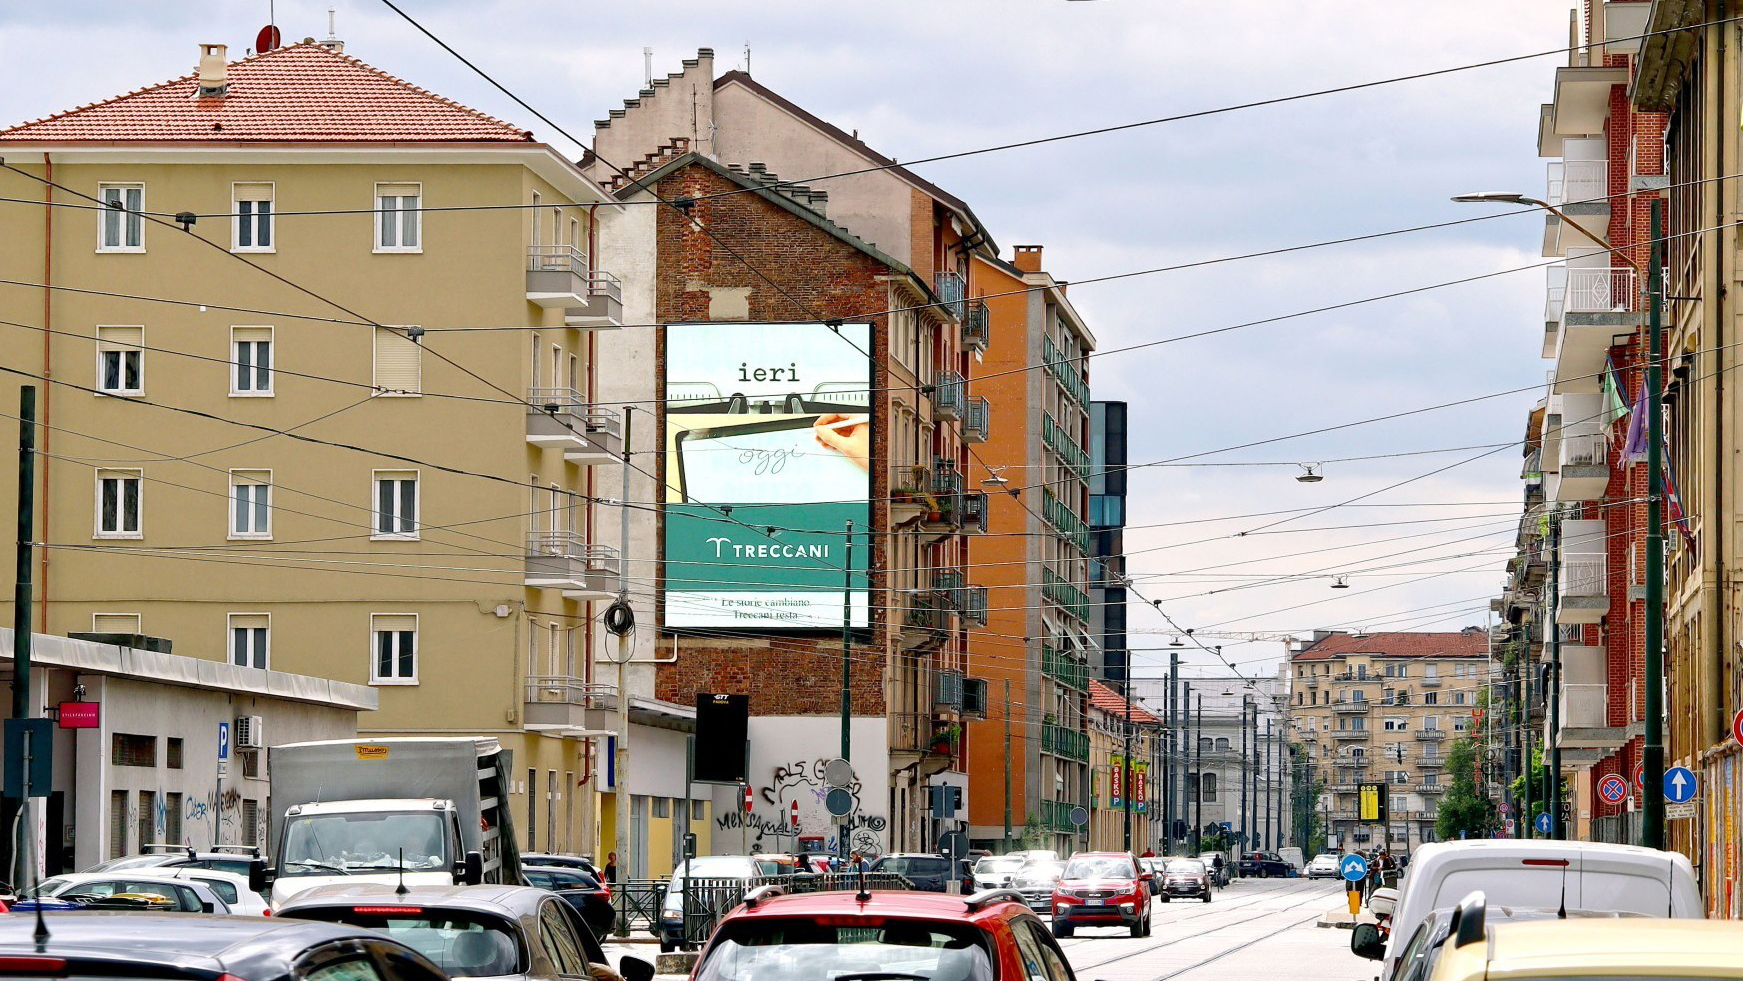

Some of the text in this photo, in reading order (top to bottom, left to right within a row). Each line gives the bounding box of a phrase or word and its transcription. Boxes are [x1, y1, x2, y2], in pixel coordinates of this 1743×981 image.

[738, 362, 800, 382] ieri
[738, 444, 806, 476] oggi
[733, 544, 829, 558] TRECCANI
[733, 610, 773, 619] Treccani
[220, 725, 228, 756] P
[1113, 797, 1120, 805] P
[1138, 802, 1144, 810] P
